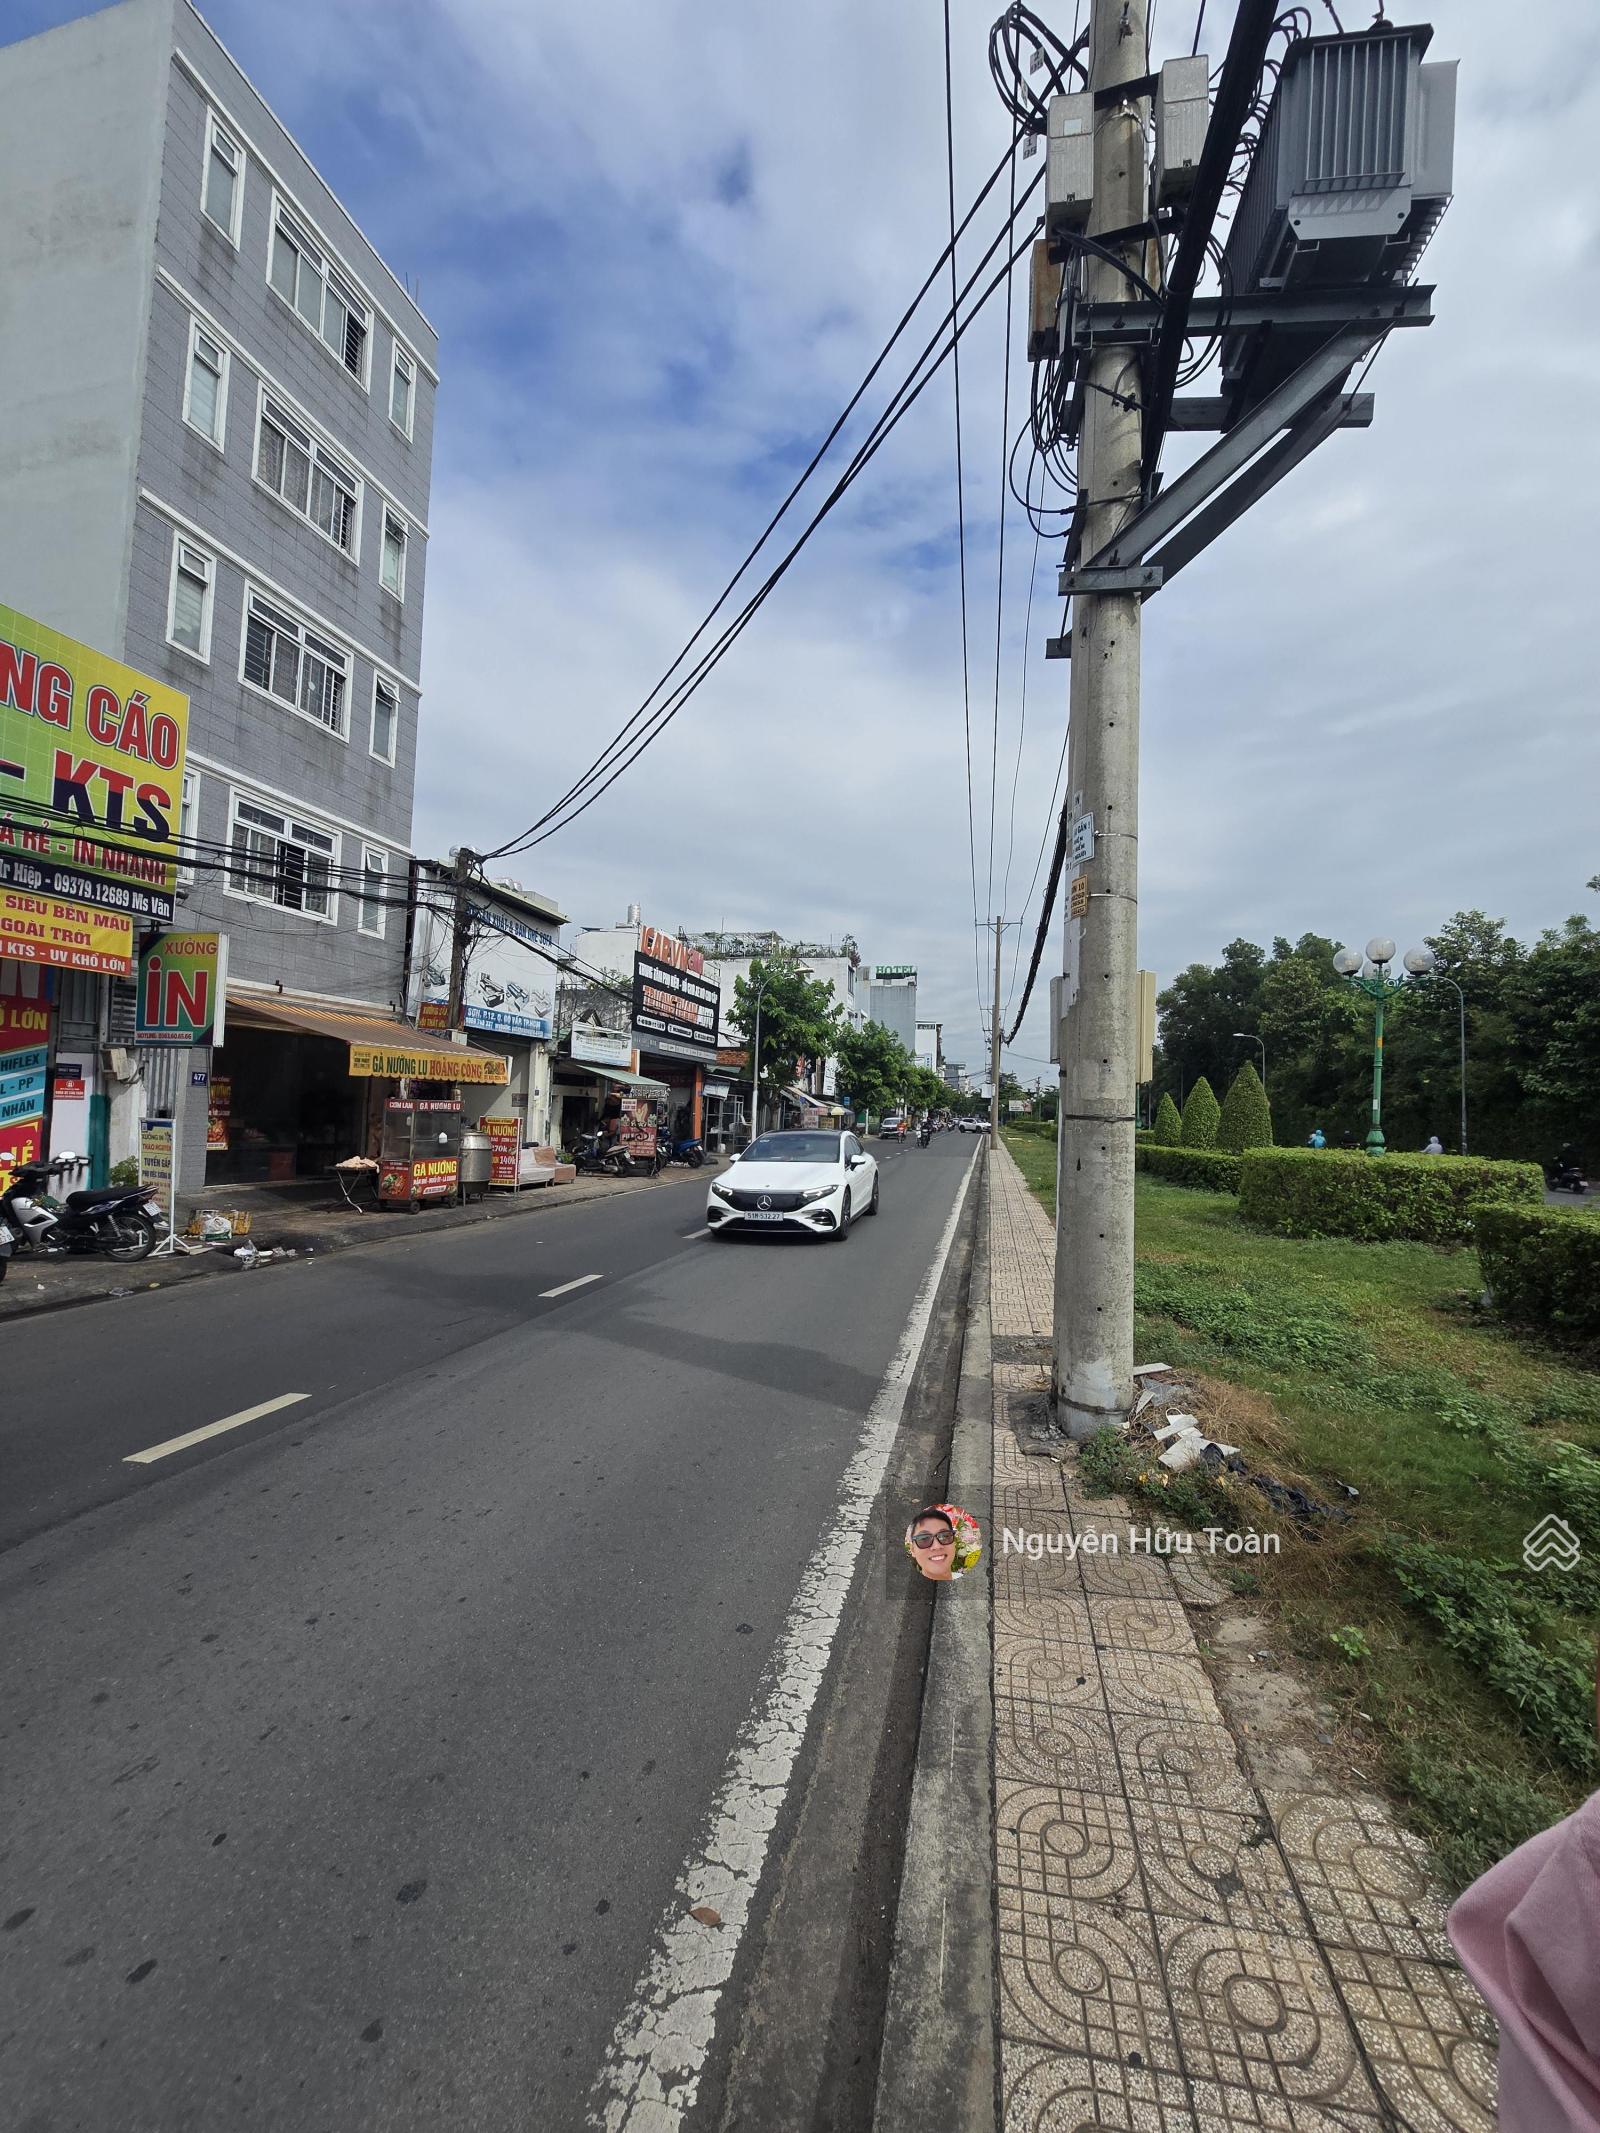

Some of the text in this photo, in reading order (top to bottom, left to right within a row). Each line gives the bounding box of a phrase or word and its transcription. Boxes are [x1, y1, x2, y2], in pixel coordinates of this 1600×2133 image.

[86, 685, 180, 770] CÁO
[52, 749, 172, 843] KTS
[102, 846, 168, 887] NHANH
[13, 862, 42, 889] Hiệp
[54, 872, 129, 907] 09379.12689
[131, 891, 149, 912] Ms
[151, 897, 170, 917] Vân
[5, 894, 48, 915] SIÊU
[51, 926, 92, 946] TRỜI
[164, 937, 218, 955] XƯỞNG
[7, 942, 36, 957] KTS
[51, 949, 68, 962] UV
[72, 952, 99, 967] KHỔ
[102, 957, 127, 972] LỚN
[875, 965, 917, 974] HOTEL
[10, 1006, 48, 1031] LỚN
[373, 1052, 383, 1073] GÀ
[387, 1054, 416, 1075] NƯỚNG
[418, 1059, 428, 1075] LU
[18, 1077, 34, 1091] PP
[193, 1073, 206, 1081] 477
[413, 1161, 426, 1177] GÀ
[429, 1159, 457, 1175] NƯỚNG
